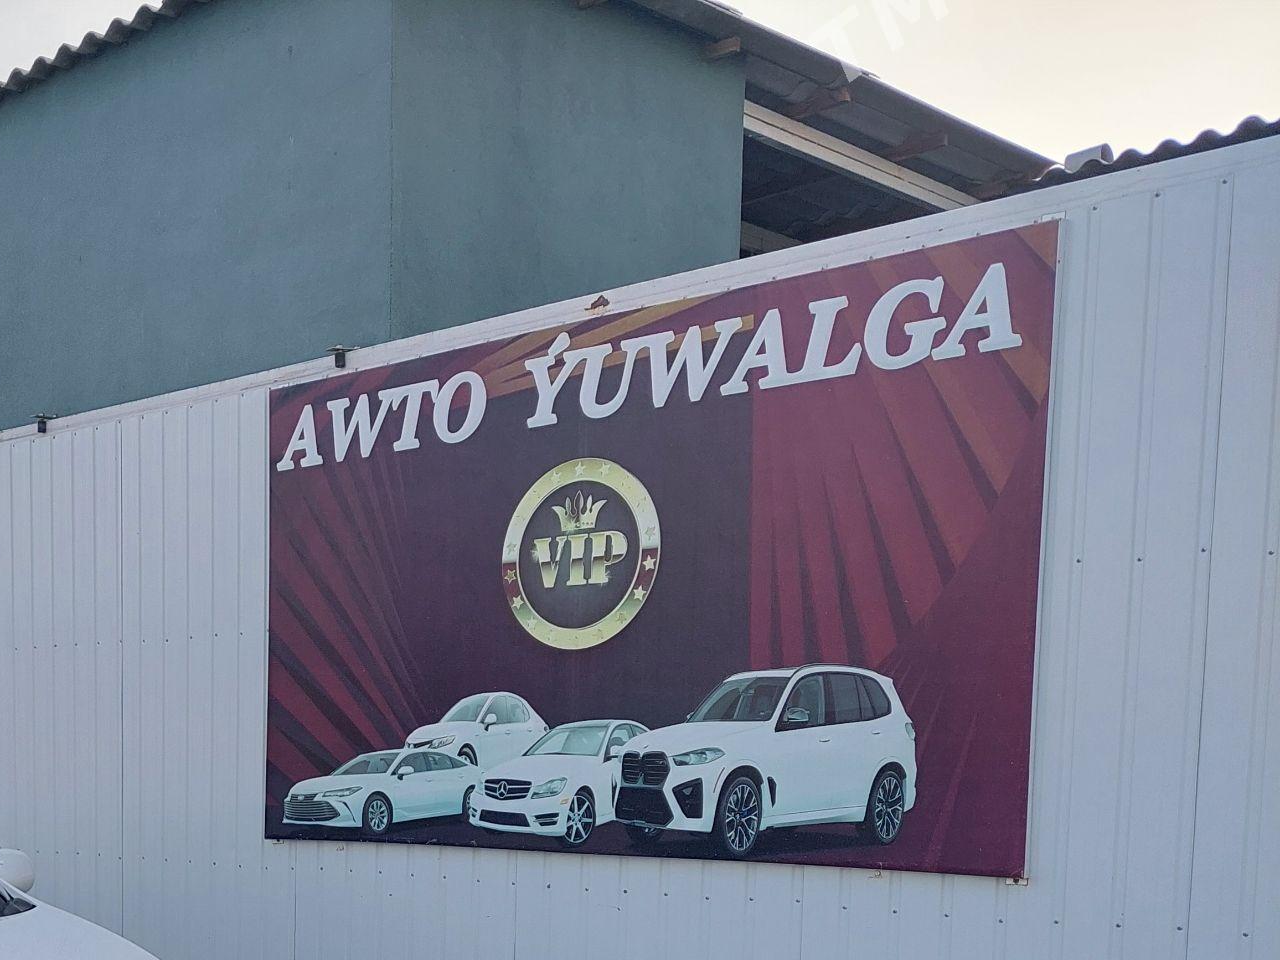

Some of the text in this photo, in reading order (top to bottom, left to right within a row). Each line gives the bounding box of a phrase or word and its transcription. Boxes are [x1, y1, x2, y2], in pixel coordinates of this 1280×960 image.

[276, 262, 1022, 471] AWTO ÝUWALGA
[533, 530, 628, 588] VIP
